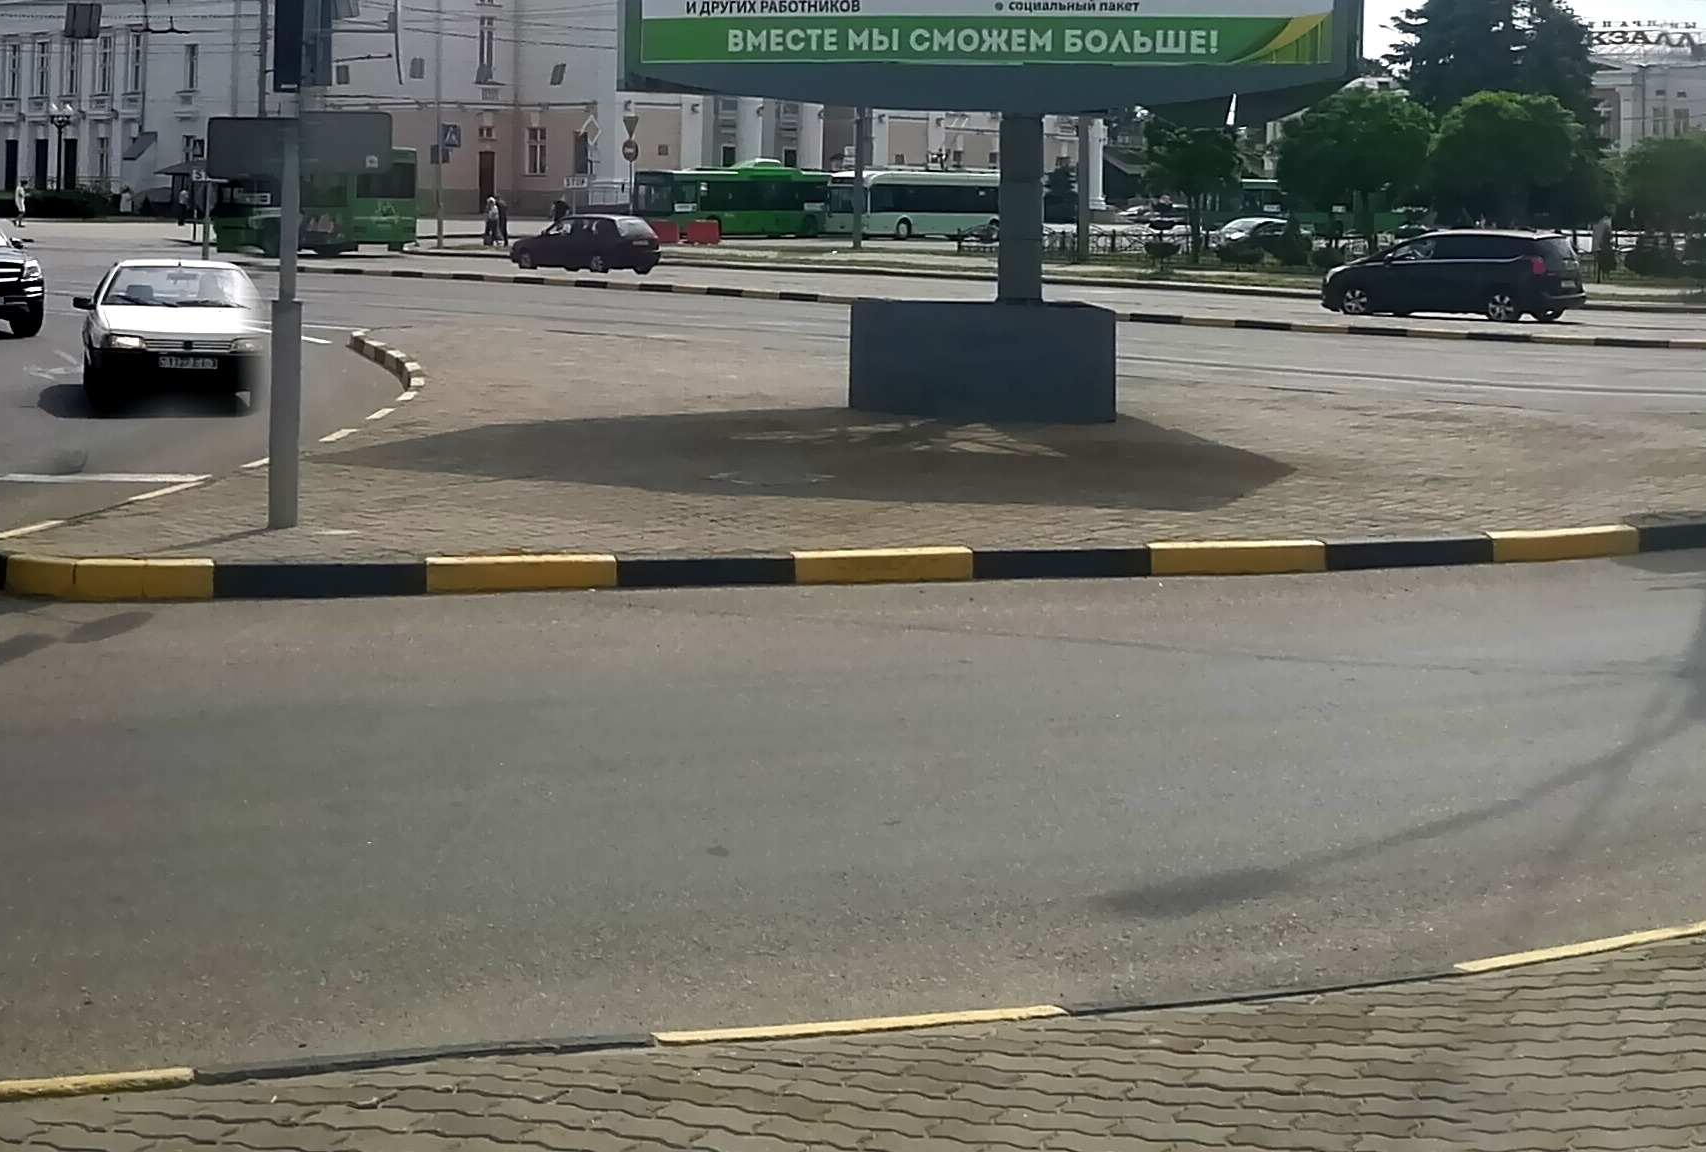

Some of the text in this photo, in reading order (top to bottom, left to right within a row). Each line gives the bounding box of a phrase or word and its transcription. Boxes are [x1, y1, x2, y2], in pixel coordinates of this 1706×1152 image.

[686, 0, 861, 17] И ДРУГИХ РАБОТНИКОВ
[1008, 0, 1140, 14] социальный пакет
[727, 28, 1219, 55] ВМЕСТЕ МЫ СМОЖЕМ БОЛЬШЕ!
[565, 177, 588, 188] STOP
